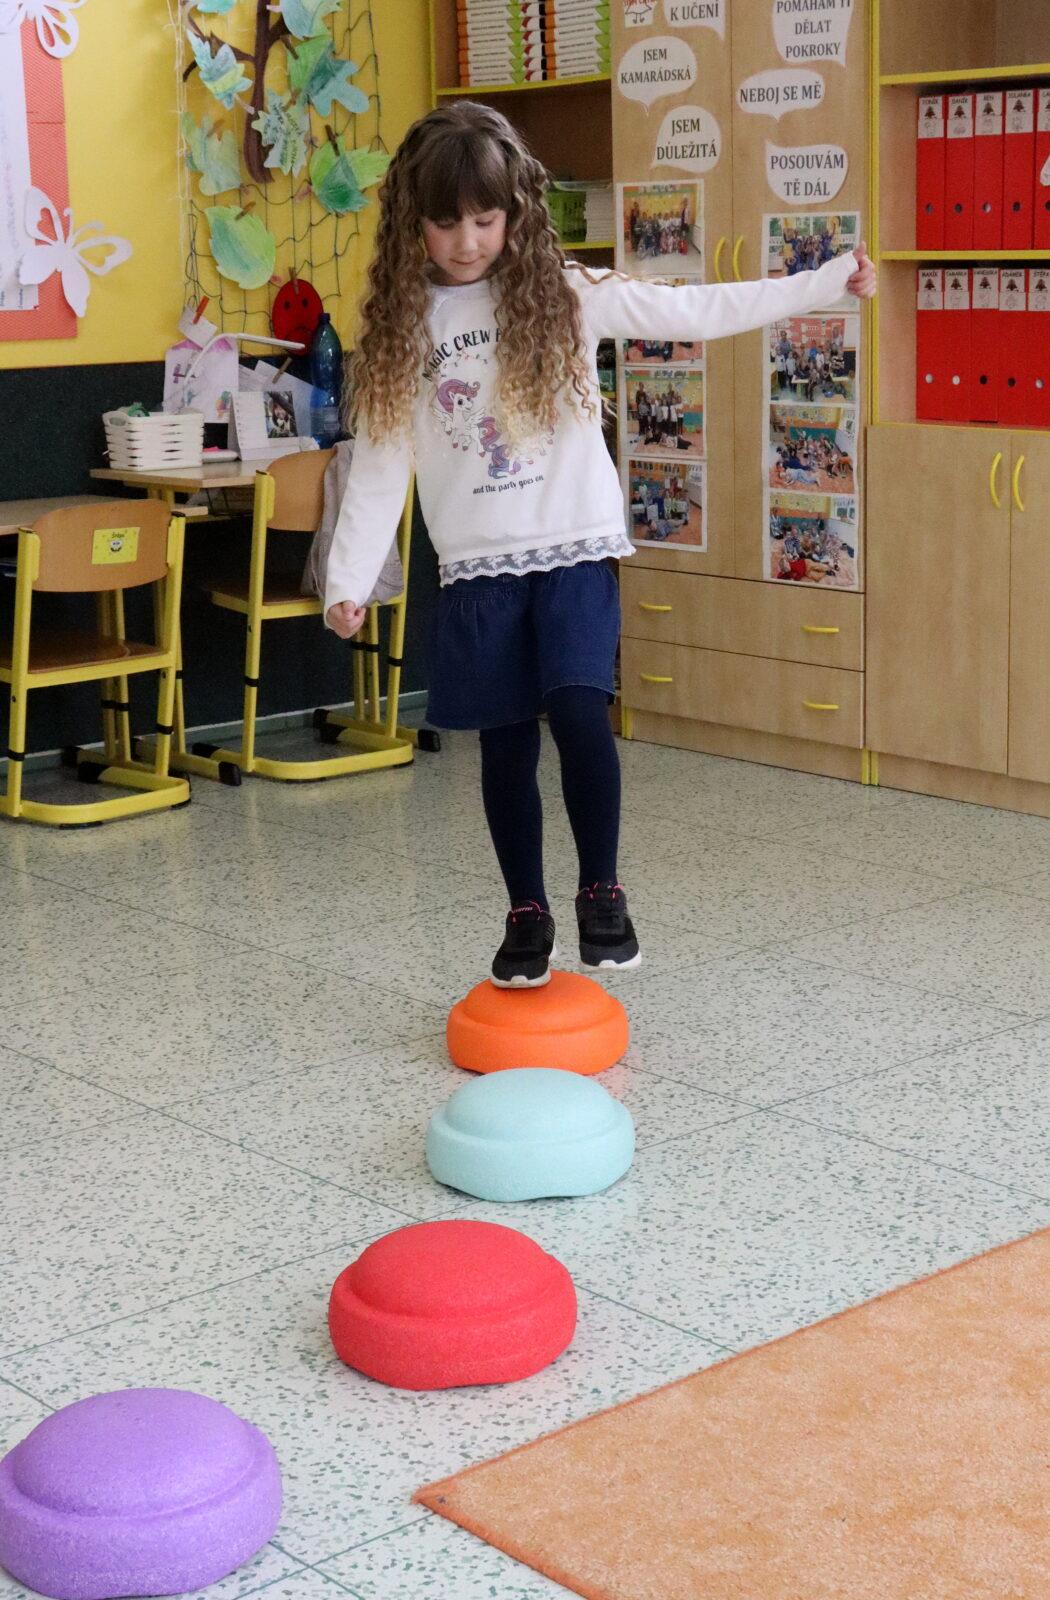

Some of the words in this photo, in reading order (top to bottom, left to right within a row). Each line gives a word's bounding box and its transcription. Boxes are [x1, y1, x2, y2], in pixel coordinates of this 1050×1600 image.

[670, 7, 678, 21] K
[795, 19, 832, 35] DĚLAT
[643, 48, 667, 63] JSEM
[785, 42, 841, 58] POKROKY
[620, 65, 691, 84] KAMARÁDSKÁ
[740, 86, 780, 104] NEBOJ
[783, 85, 798, 101] SE
[802, 81, 822, 100] MĚ
[671, 118, 700, 136] JSEM
[656, 139, 718, 160] DŮLEŽITÁ
[770, 150, 844, 170] POSOUVÁM
[784, 178, 801, 196] TĚ
[804, 177, 831, 196] DÁL
[422, 342, 452, 382] MAGIC
[453, 328, 490, 351] CREW
[472, 485, 485, 495] and
[486, 484, 497, 493] the
[498, 481, 517, 493] party
[518, 478, 534, 489] goes
